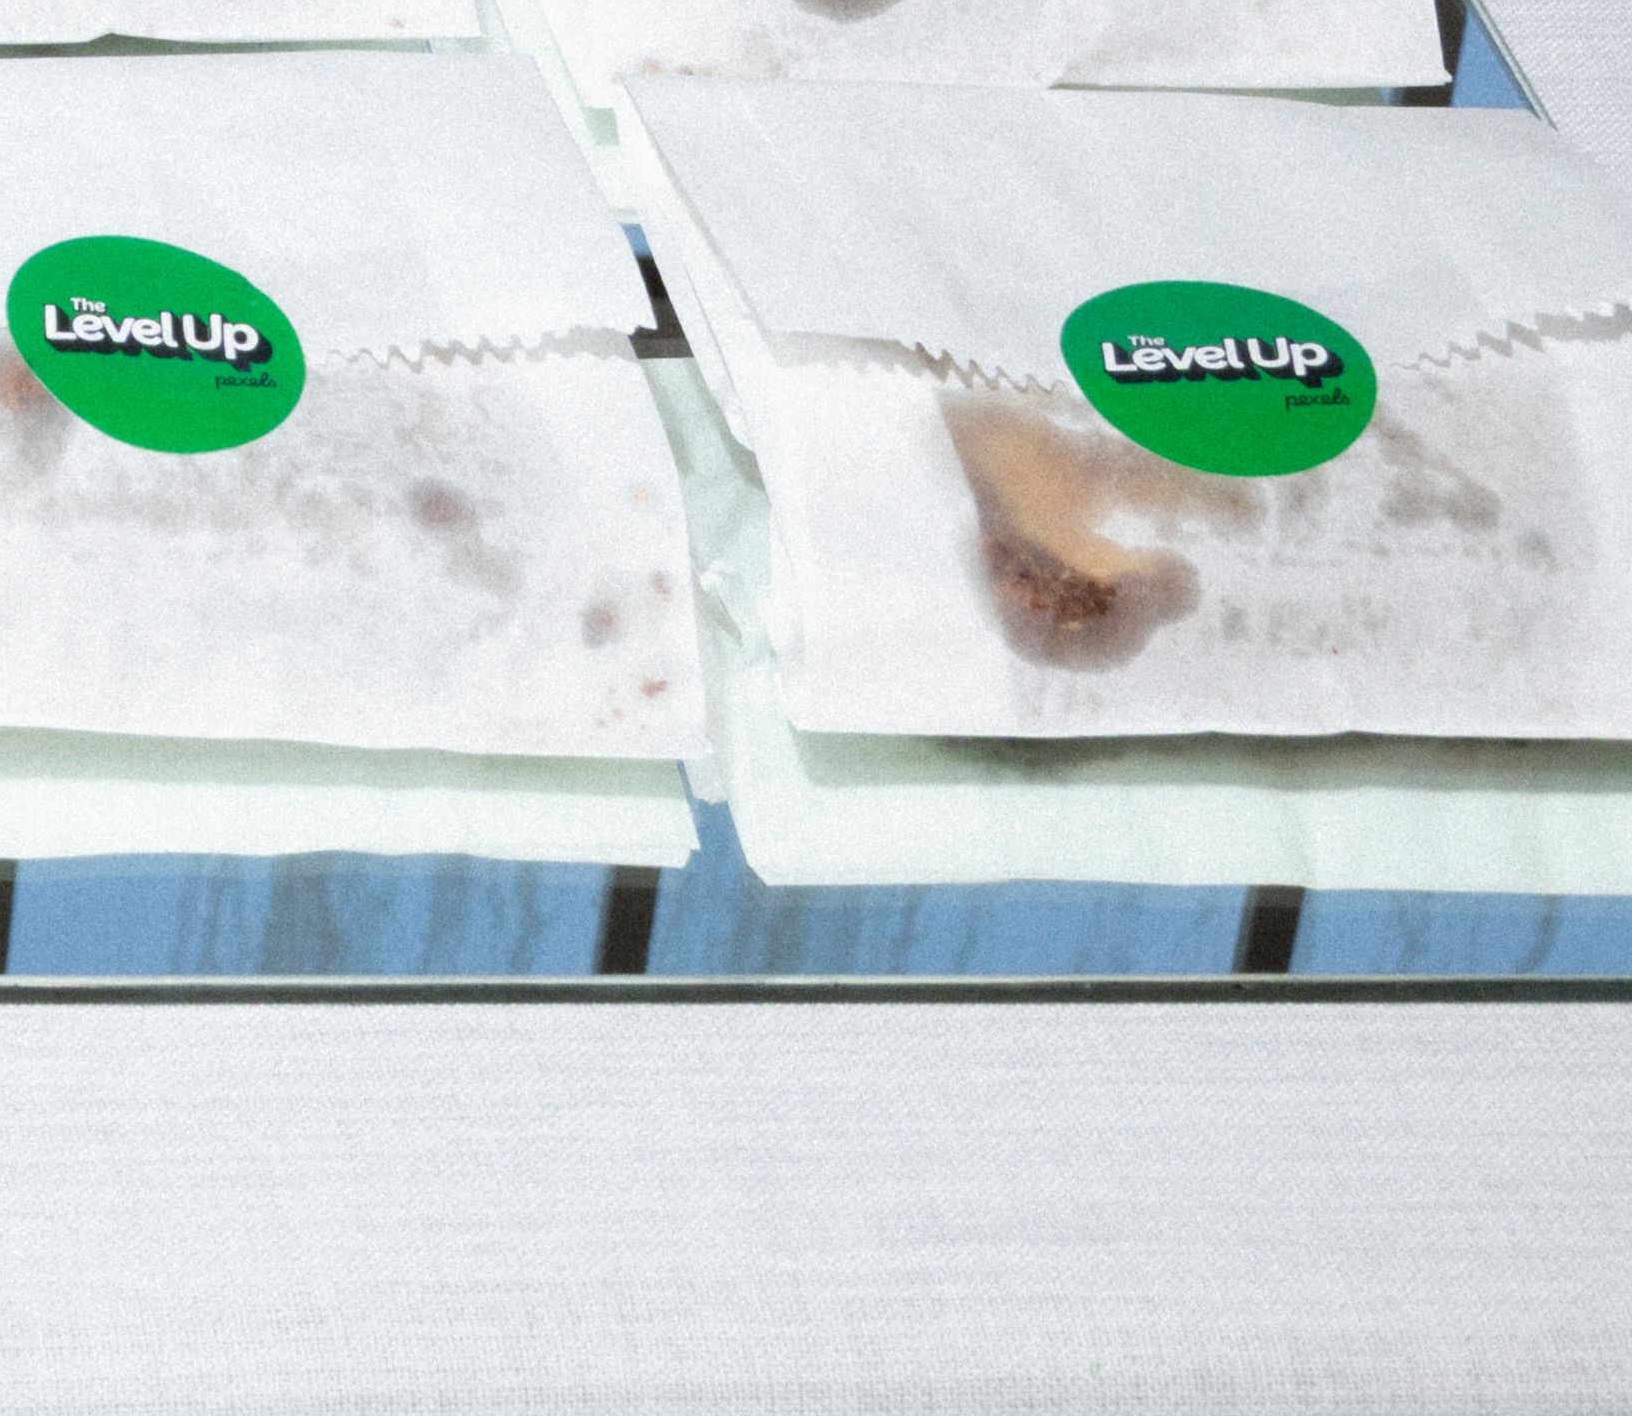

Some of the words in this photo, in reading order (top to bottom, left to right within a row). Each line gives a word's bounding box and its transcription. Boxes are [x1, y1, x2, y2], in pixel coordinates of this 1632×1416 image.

[69, 296, 107, 314] The
[43, 302, 180, 351] Level
[181, 312, 263, 363] Up
[1126, 333, 1168, 348] The
[1100, 337, 1246, 375] Level
[1246, 335, 1332, 378] Up
[214, 371, 278, 390] pexels
[1284, 386, 1352, 412] pexels
